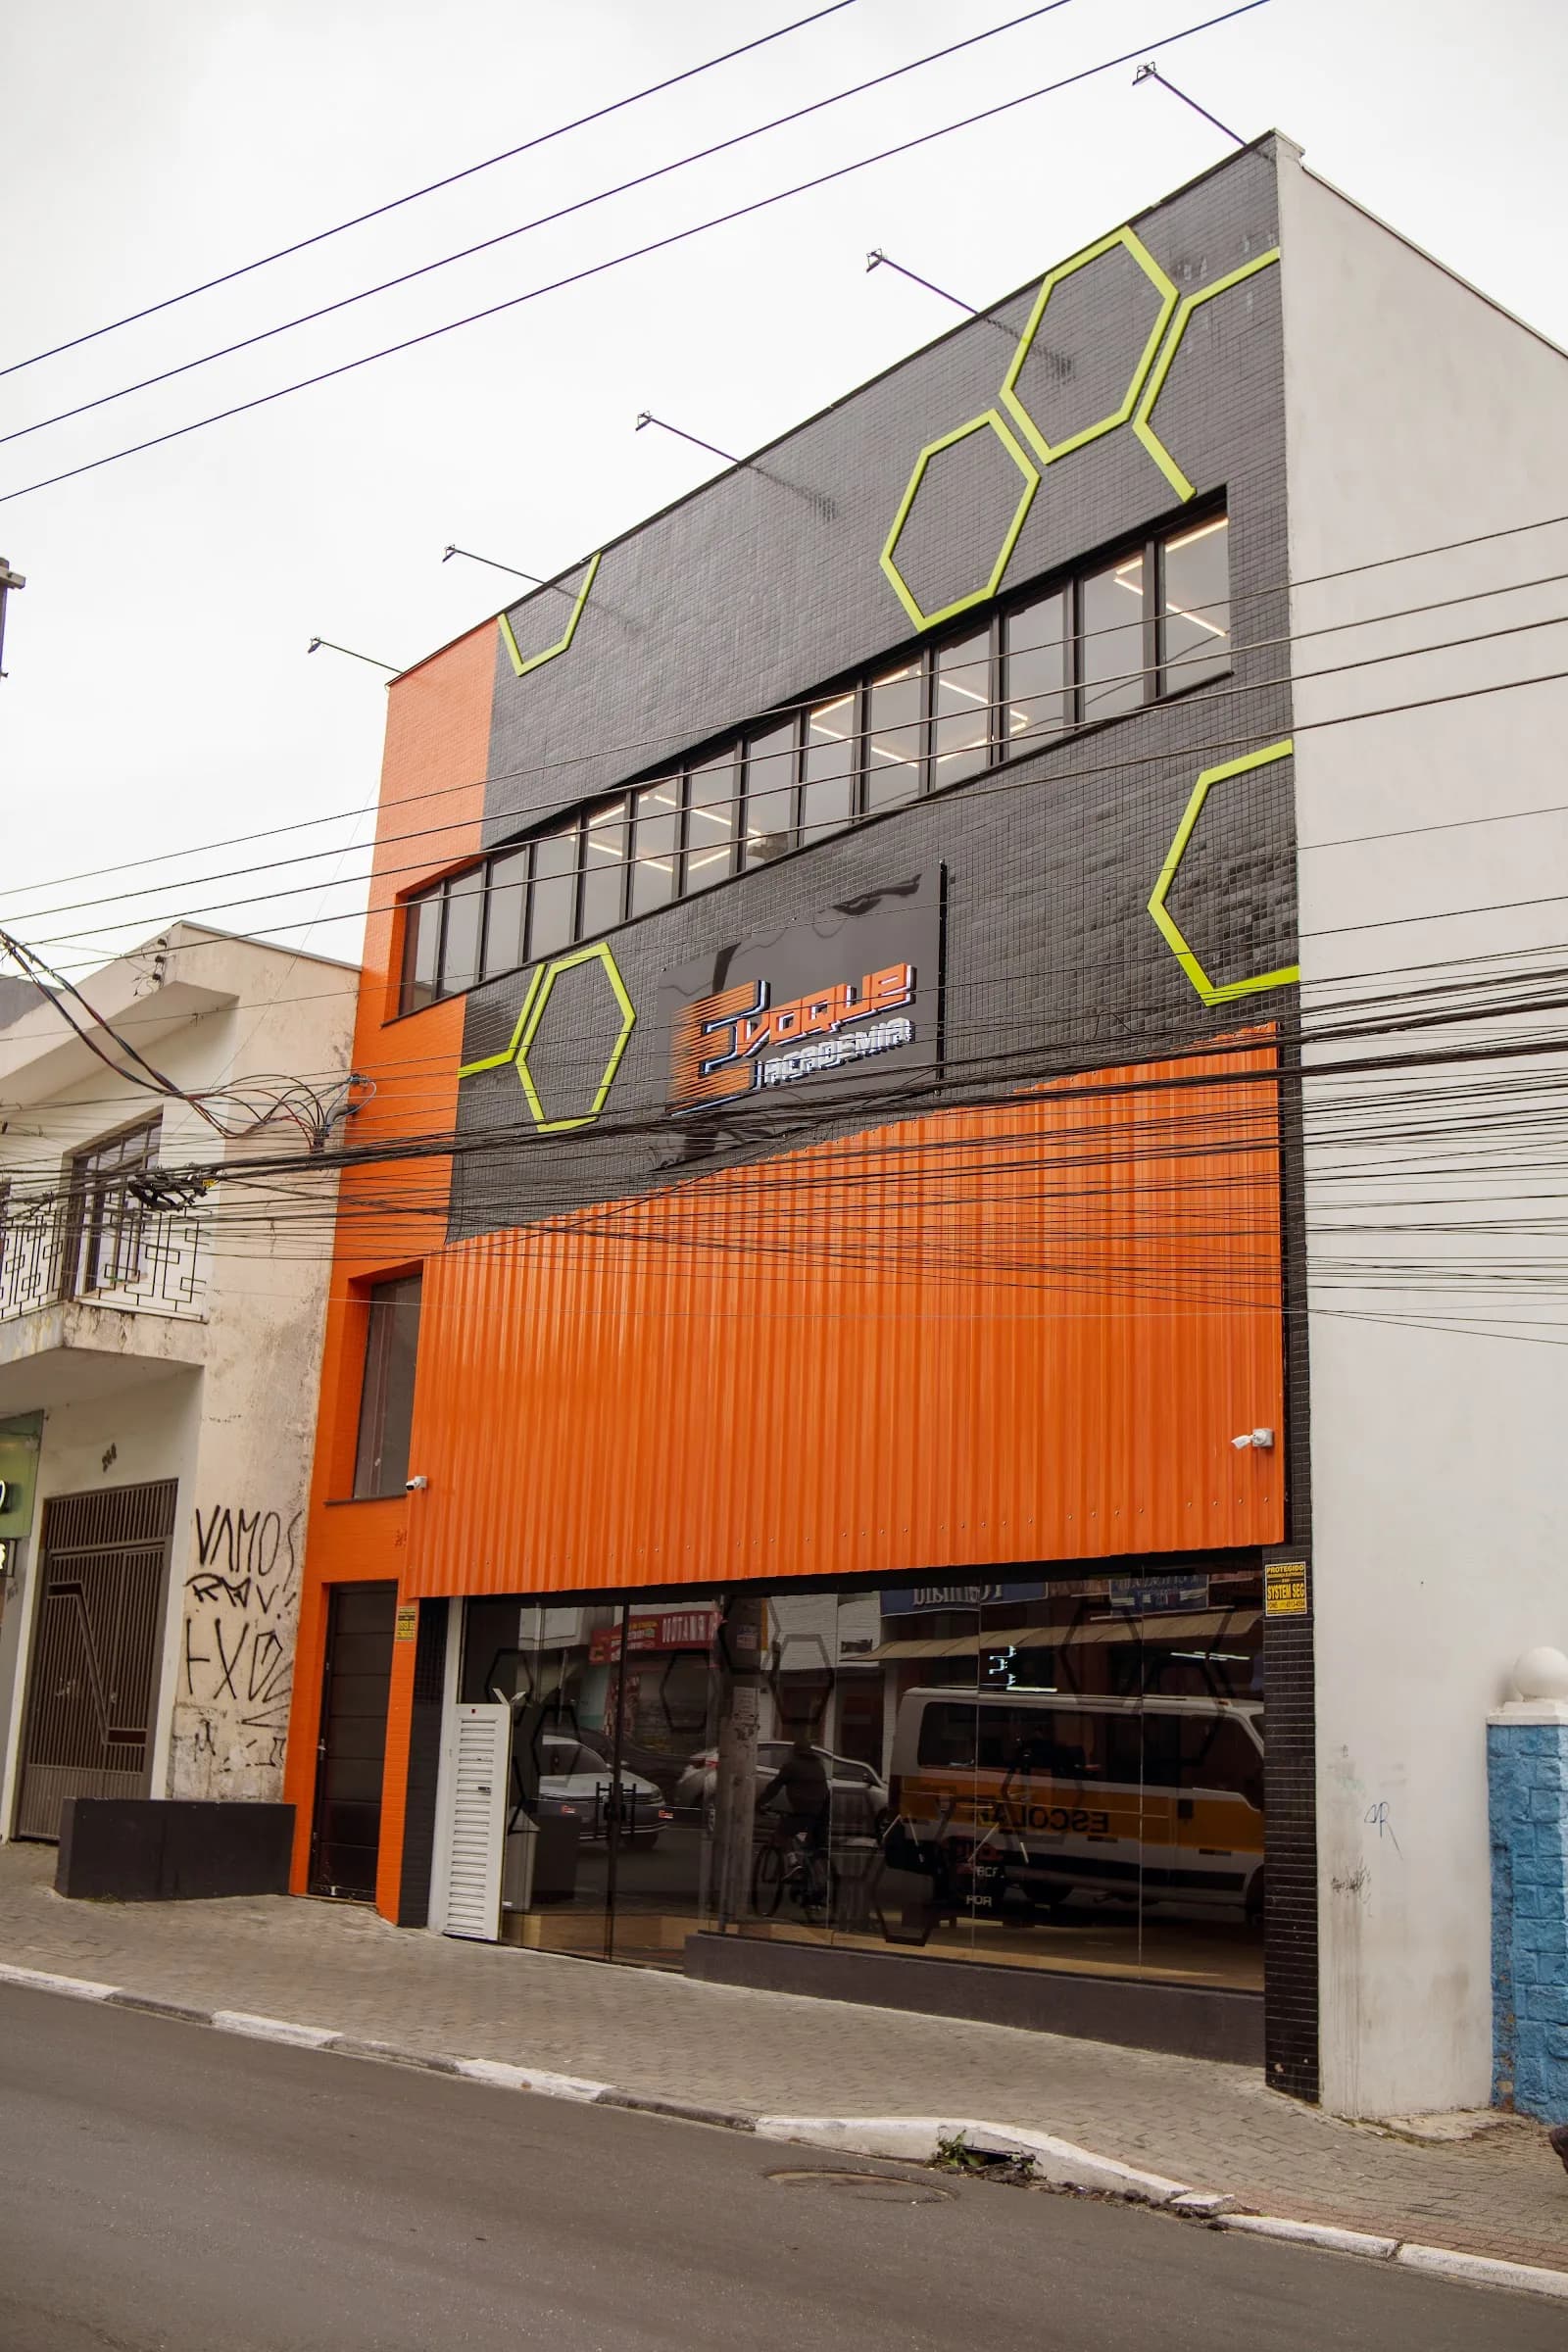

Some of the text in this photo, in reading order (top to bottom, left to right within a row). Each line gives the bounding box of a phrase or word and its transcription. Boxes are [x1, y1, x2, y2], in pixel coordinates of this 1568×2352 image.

[665, 962, 917, 1116] EVOQUE
[763, 1017, 915, 1087] ACADEMIA
[195, 1504, 303, 1592] VAMOS
[1267, 1565, 1304, 1574] PROTEGIDO
[1268, 1584, 1292, 1599] SYSTEM
